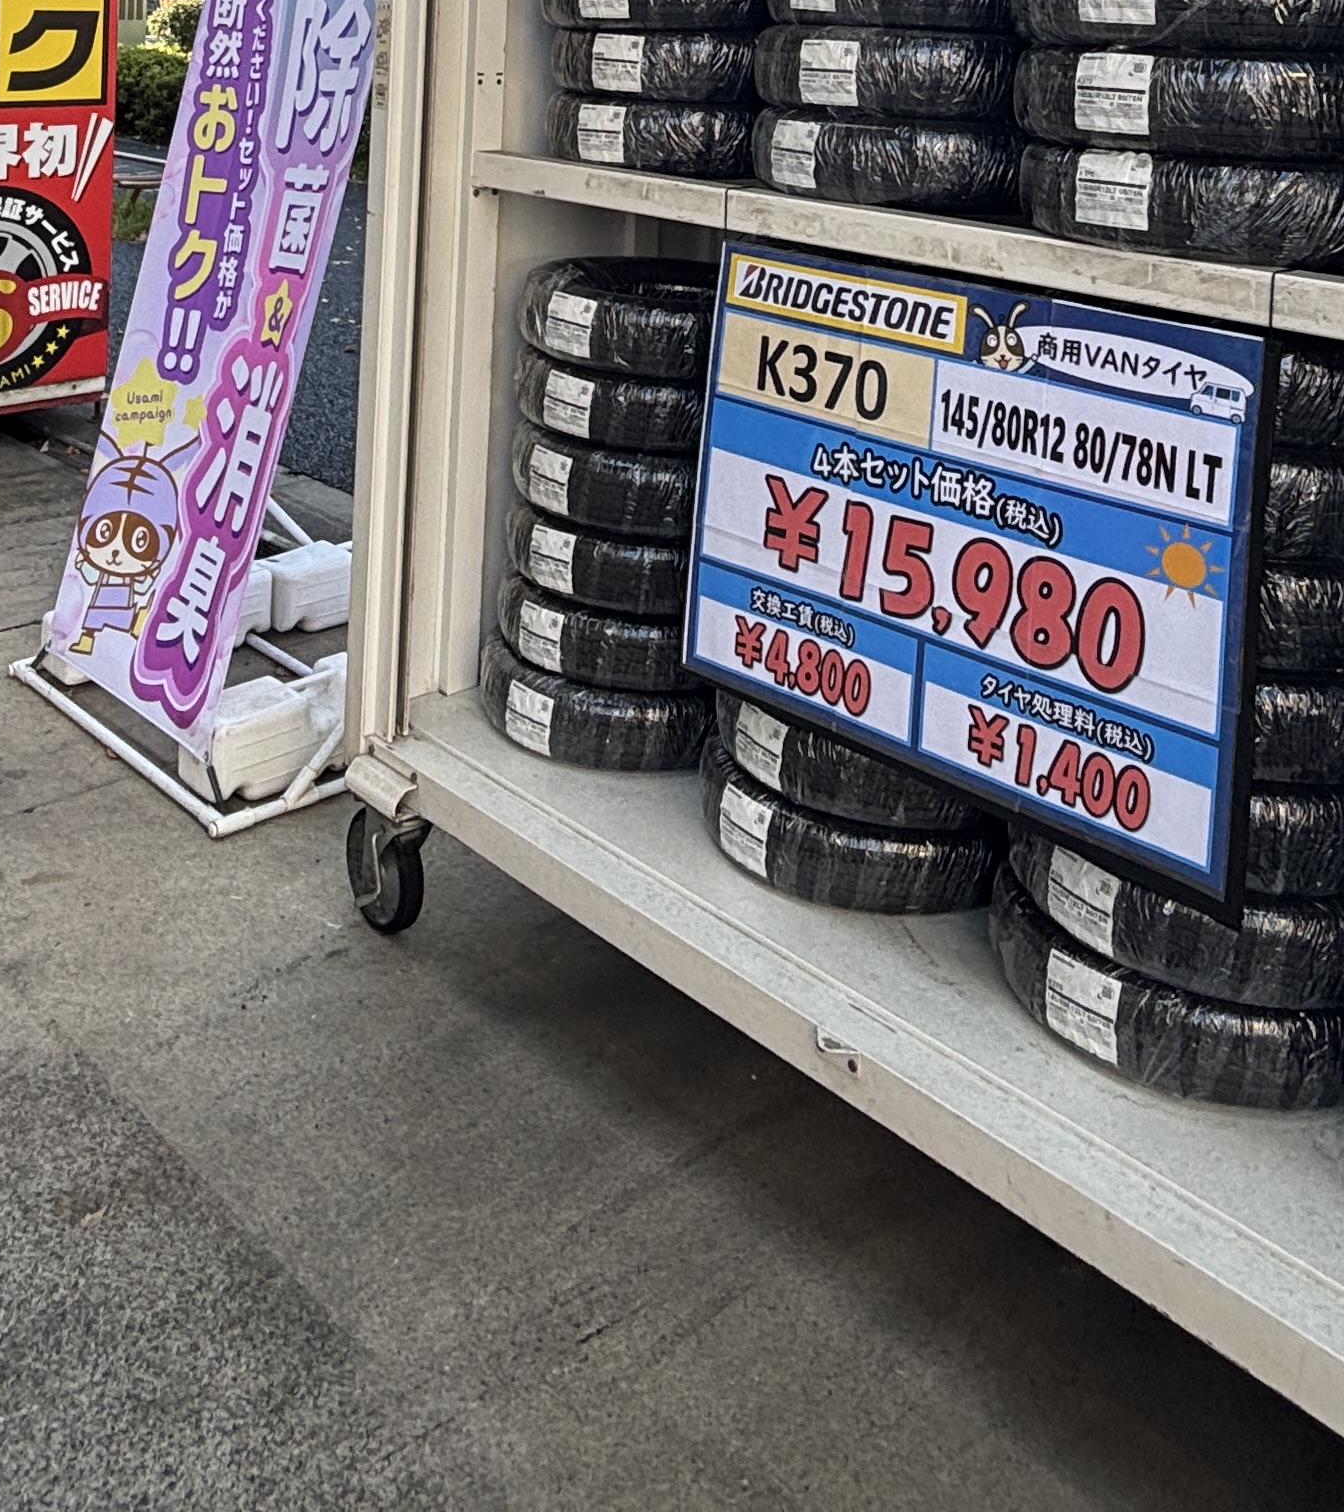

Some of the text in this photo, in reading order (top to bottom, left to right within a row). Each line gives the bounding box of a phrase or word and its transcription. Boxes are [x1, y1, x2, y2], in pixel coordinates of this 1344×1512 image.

[28, 280, 104, 316] SERVICE
[736, 264, 955, 340] BRIDGESTONE
[758, 334, 888, 421] K370
[1037, 331, 1207, 386] 商用VANタイヤ
[115, 407, 173, 424] campaign
[126, 391, 164, 405] Usami
[941, 388, 1223, 505] 145/80R12 80/78N LT
[764, 474, 1144, 693] ¥15,980
[734, 615, 872, 717] ¥4,800
